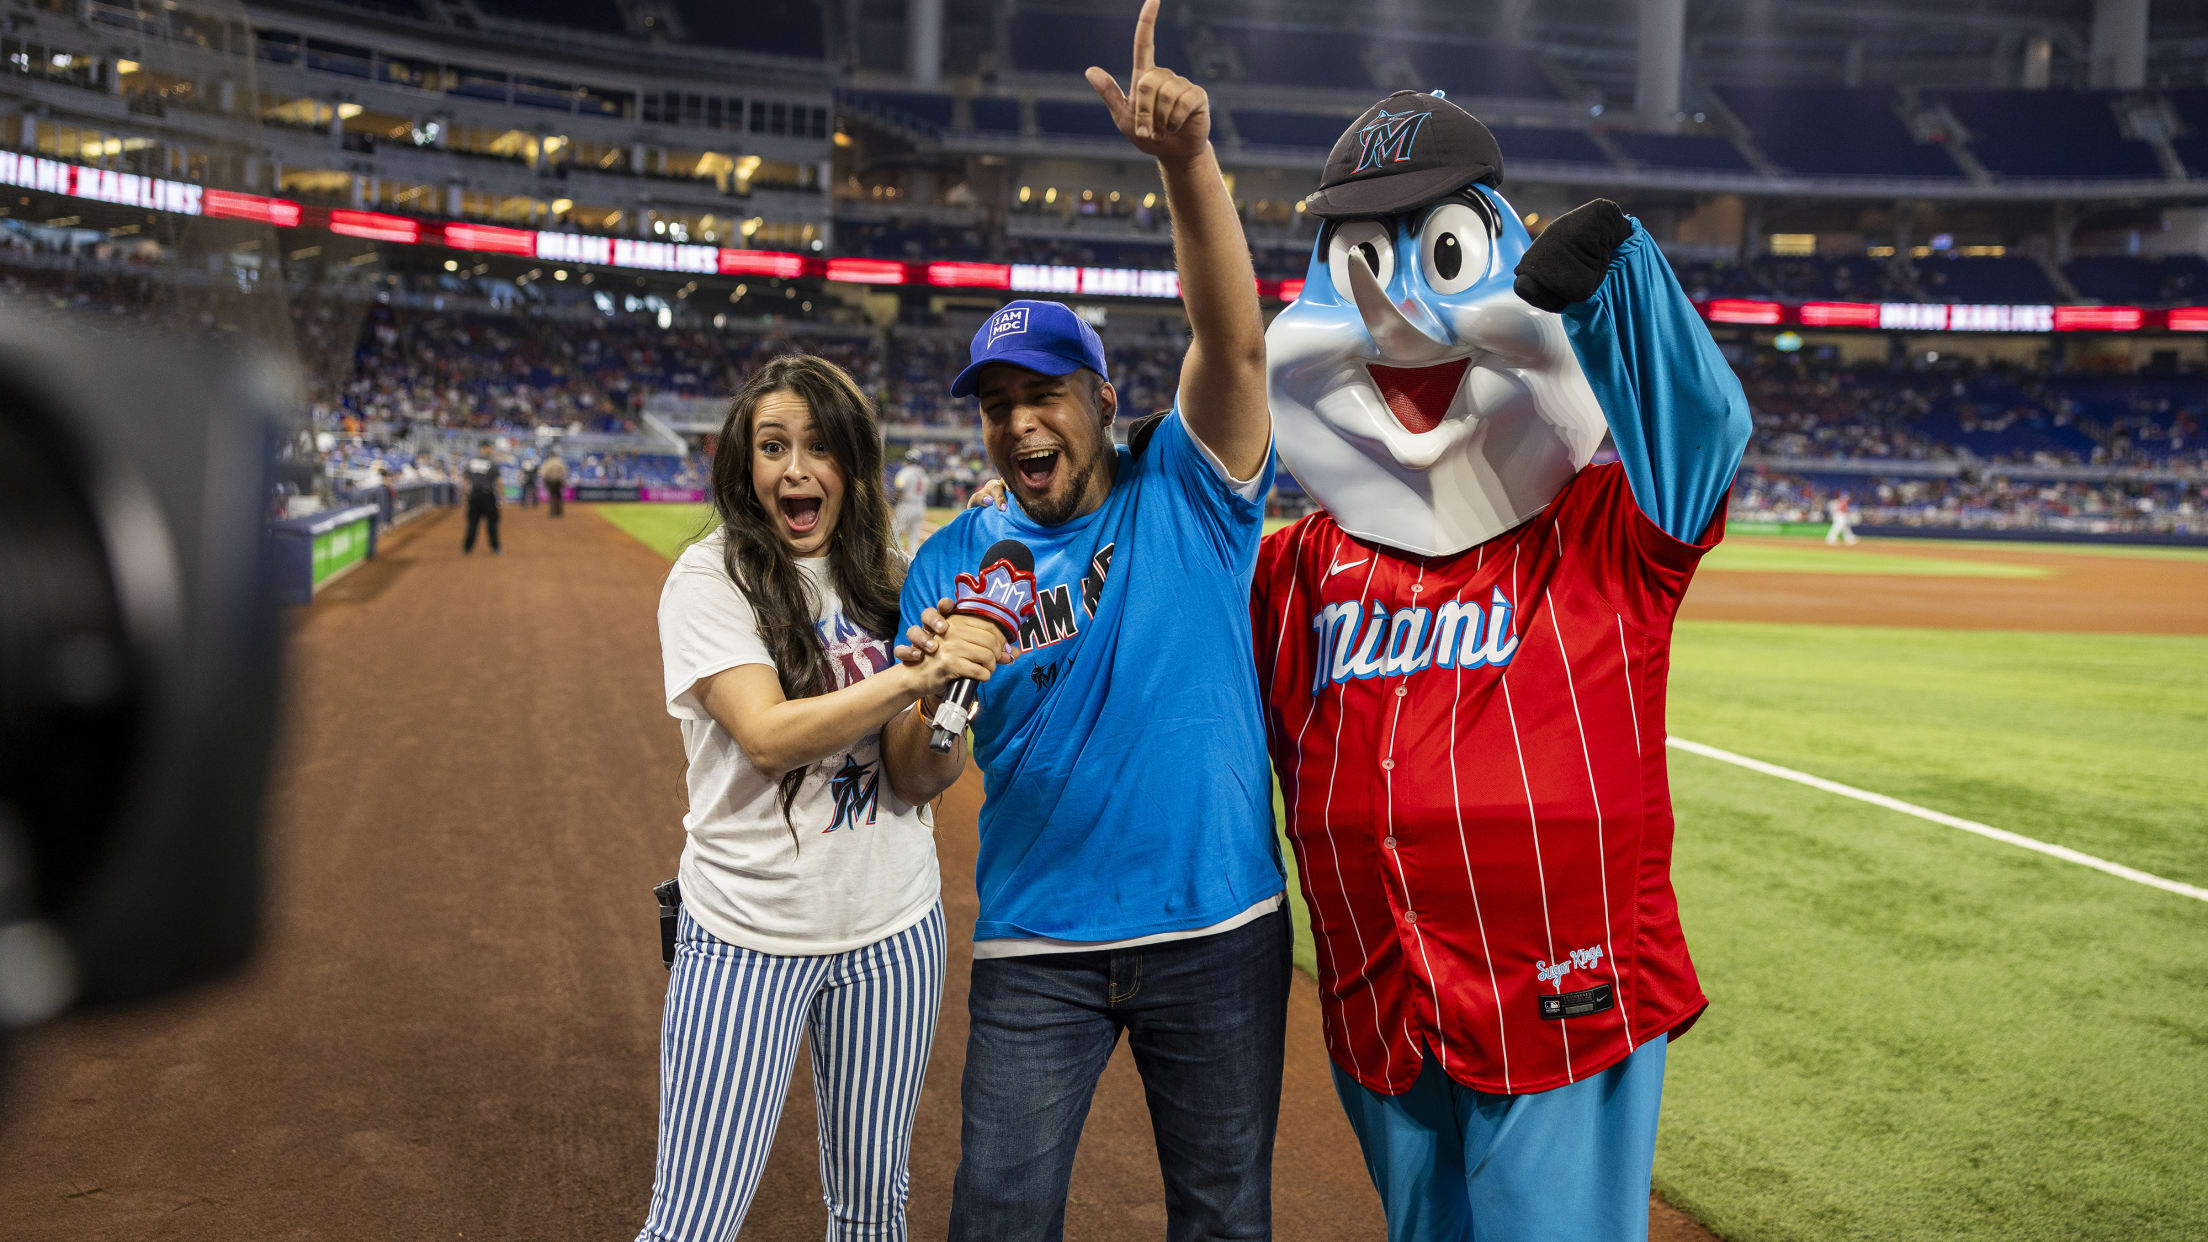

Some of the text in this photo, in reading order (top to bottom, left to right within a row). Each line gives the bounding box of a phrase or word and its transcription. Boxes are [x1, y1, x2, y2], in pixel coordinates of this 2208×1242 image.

[992, 320, 1021, 336] MDC
[1001, 311, 1022, 322] AM
[988, 577, 1026, 612] MM
[1312, 585, 1520, 697] Miami
[1536, 944, 1604, 987] Sugar Kings
